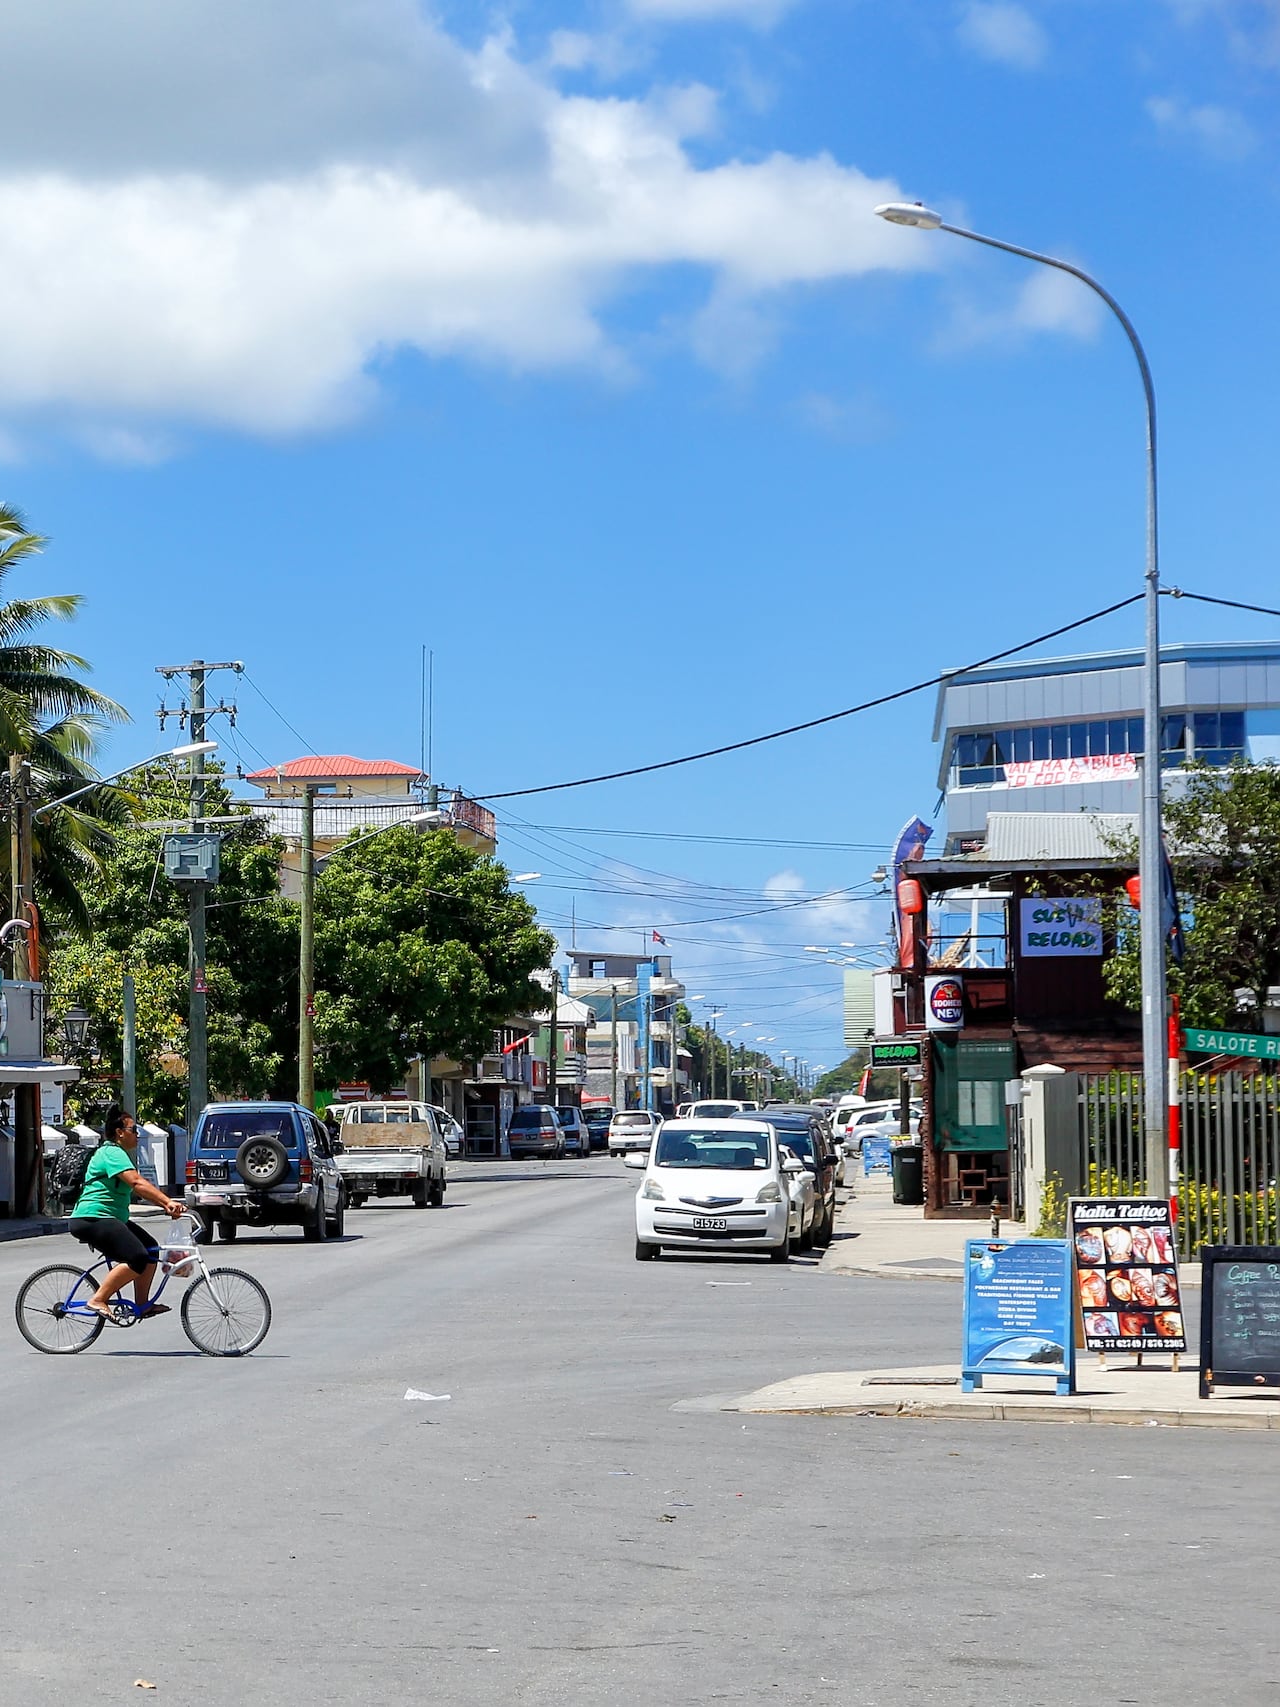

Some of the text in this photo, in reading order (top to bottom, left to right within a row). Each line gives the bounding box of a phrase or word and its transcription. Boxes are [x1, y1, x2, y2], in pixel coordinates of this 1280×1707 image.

[1027, 931, 1097, 948] RELOAD
[937, 1008, 962, 1019] NEW
[1196, 1034, 1257, 1053] SALOTE
[874, 1046, 918, 1058] RELOAD
[1074, 1204, 1168, 1219] Kalia Tattoo
[1105, 1339, 1115, 1348] 77
